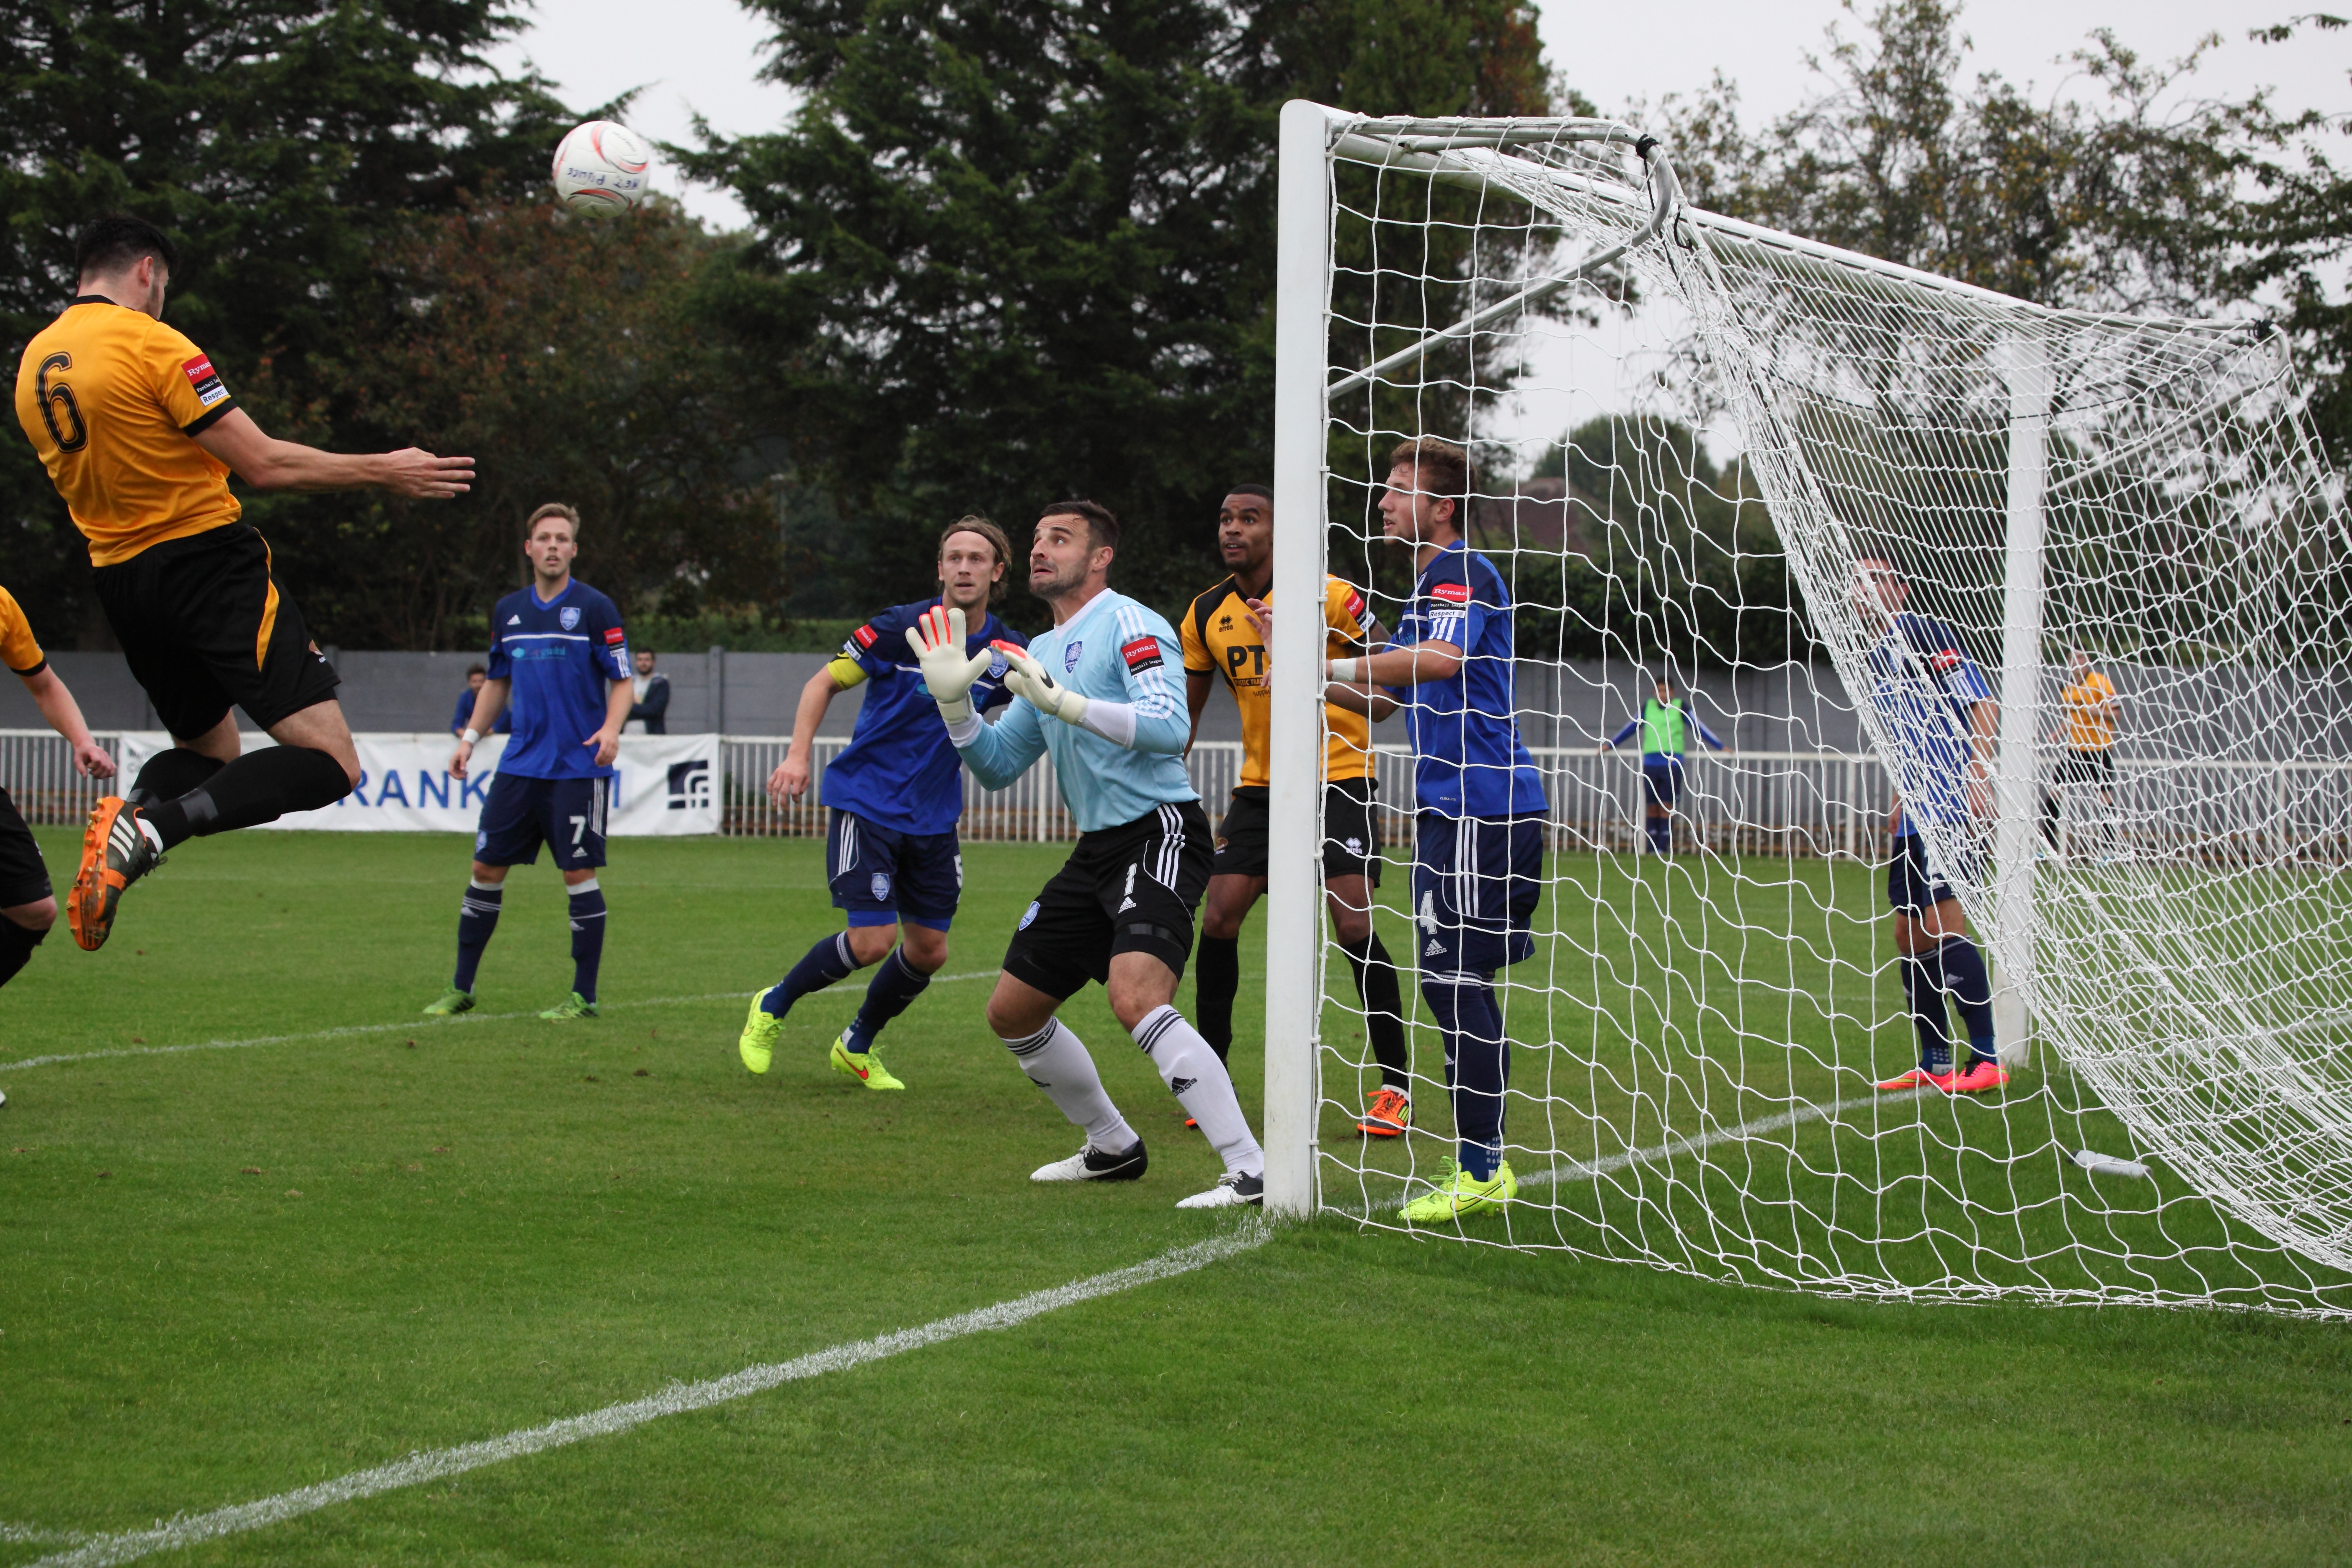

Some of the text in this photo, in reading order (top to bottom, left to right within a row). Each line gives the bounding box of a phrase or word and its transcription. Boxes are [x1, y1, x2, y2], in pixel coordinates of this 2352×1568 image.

[35, 351, 88, 454] 6
[1125, 645, 1156, 659] Ryman
[1131, 662, 1148, 672] Football
[570, 815, 585, 844] 7
[1124, 863, 1137, 896] 1
[1419, 890, 1438, 935] 4
[1425, 948, 1447, 957] adidas
